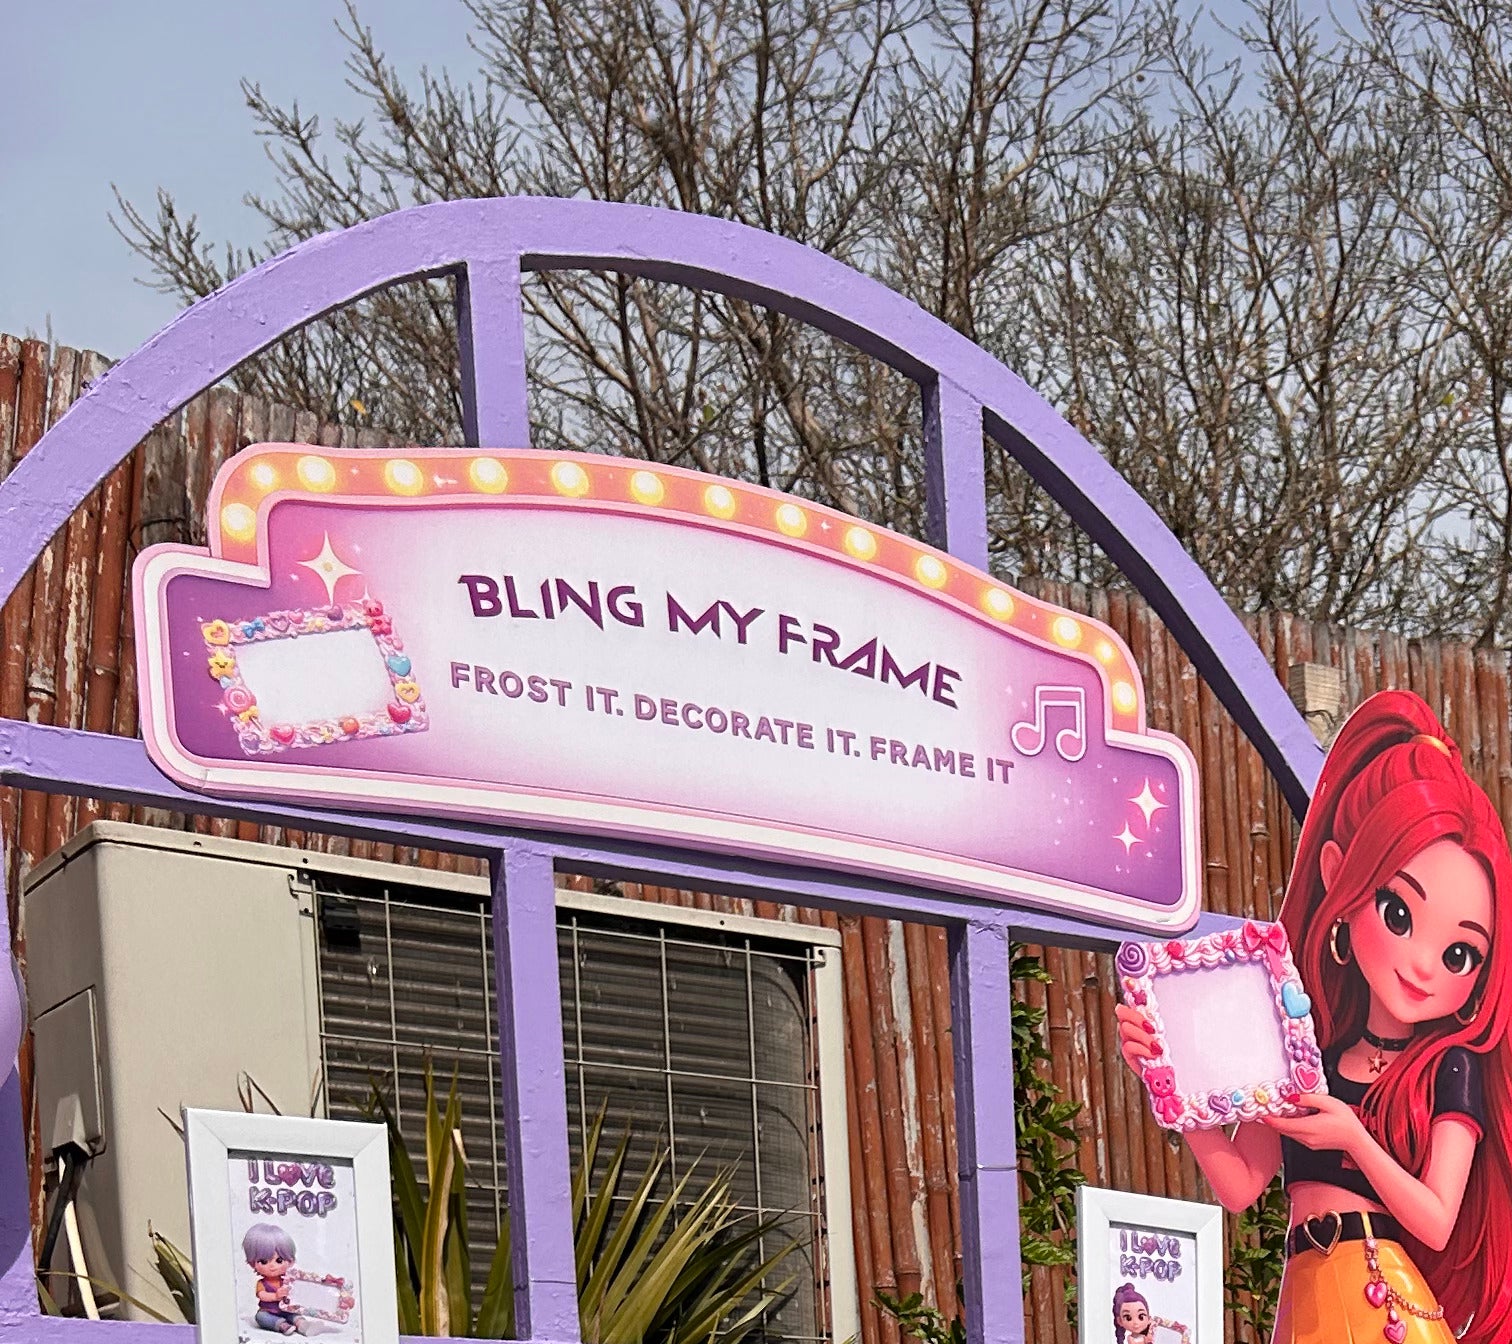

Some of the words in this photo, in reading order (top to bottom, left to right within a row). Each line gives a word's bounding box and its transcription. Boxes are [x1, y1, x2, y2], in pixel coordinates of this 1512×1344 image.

[457, 575, 645, 631] BLING
[666, 590, 766, 644] MY
[778, 614, 963, 710] FRAME
[450, 661, 572, 706] FROST
[585, 685, 624, 716] IT.
[634, 693, 815, 750] DECORATE
[826, 727, 861, 758] IT.
[870, 736, 976, 778] FRAME
[987, 757, 1015, 784] IT
[1119, 1229, 1128, 1252] I
